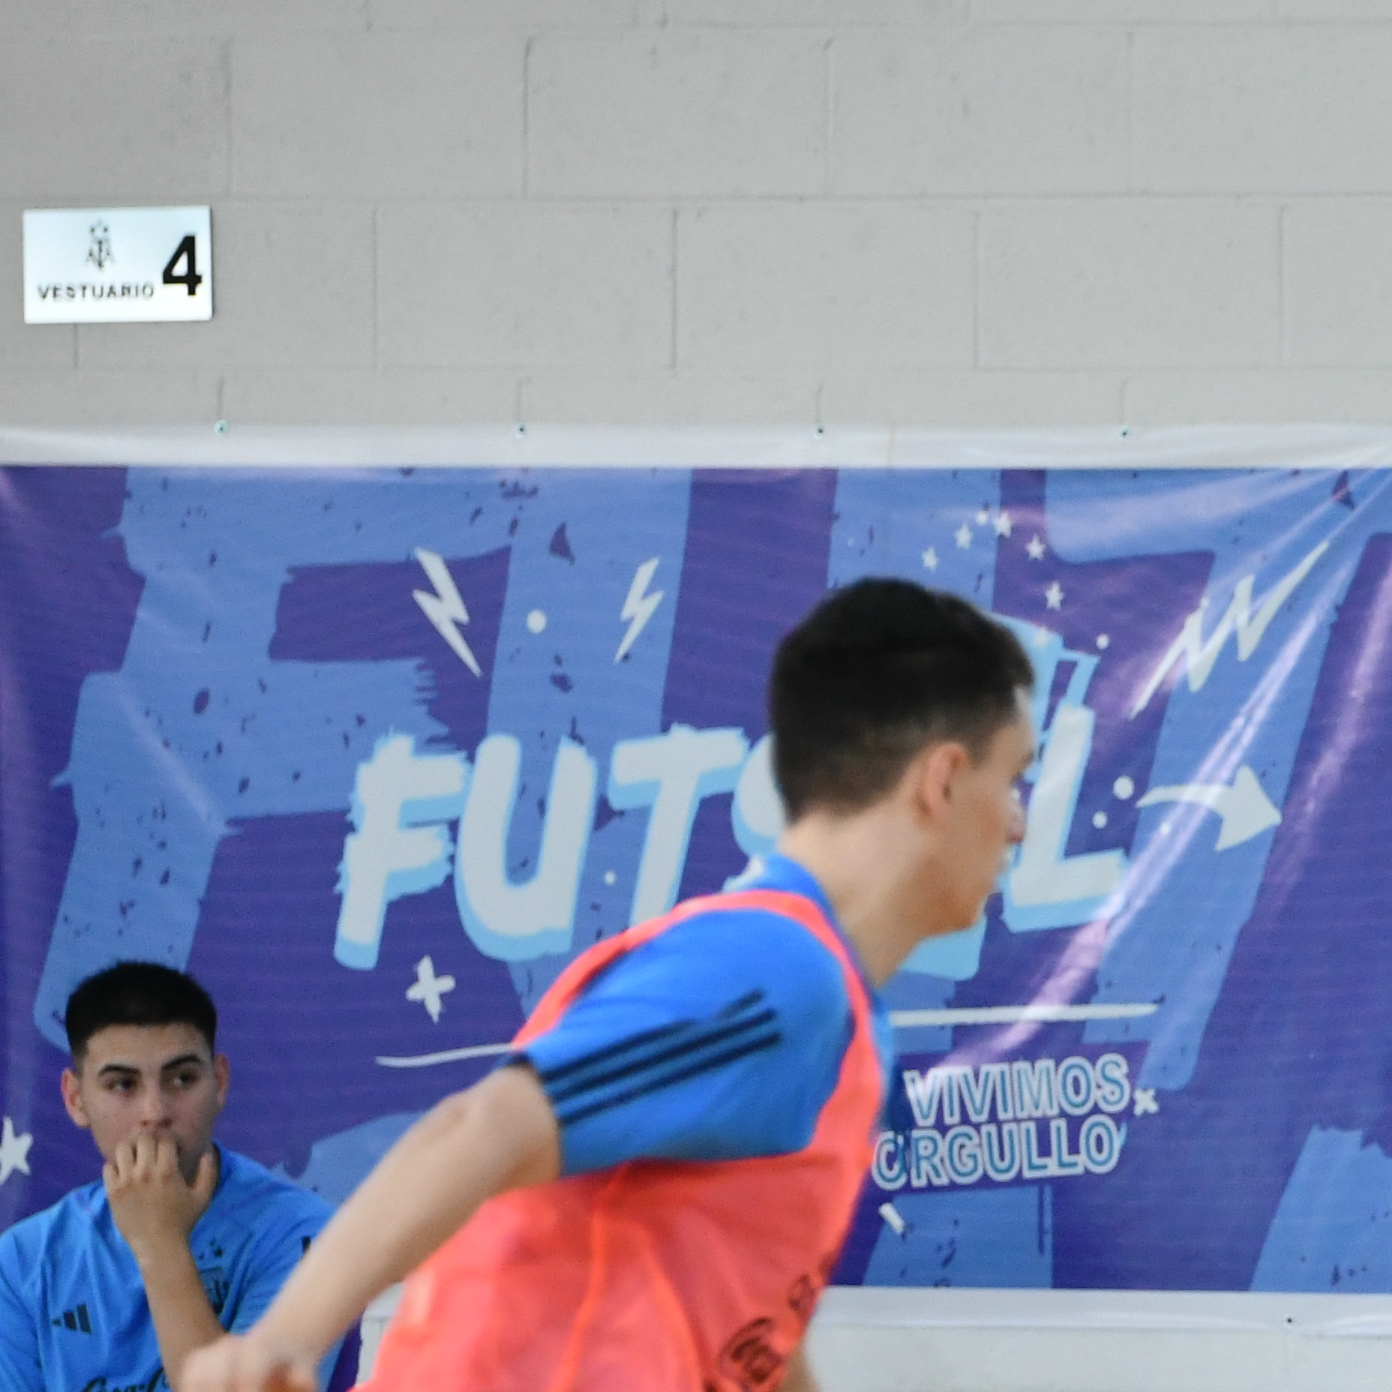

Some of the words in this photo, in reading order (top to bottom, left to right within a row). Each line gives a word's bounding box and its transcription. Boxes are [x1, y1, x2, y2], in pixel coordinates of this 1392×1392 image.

[38, 283, 154, 300] VESTUARIO
[162, 234, 203, 297] 4
[903, 1052, 1131, 1128] VIVIMOS
[871, 1113, 1120, 1191] ORGULLO
